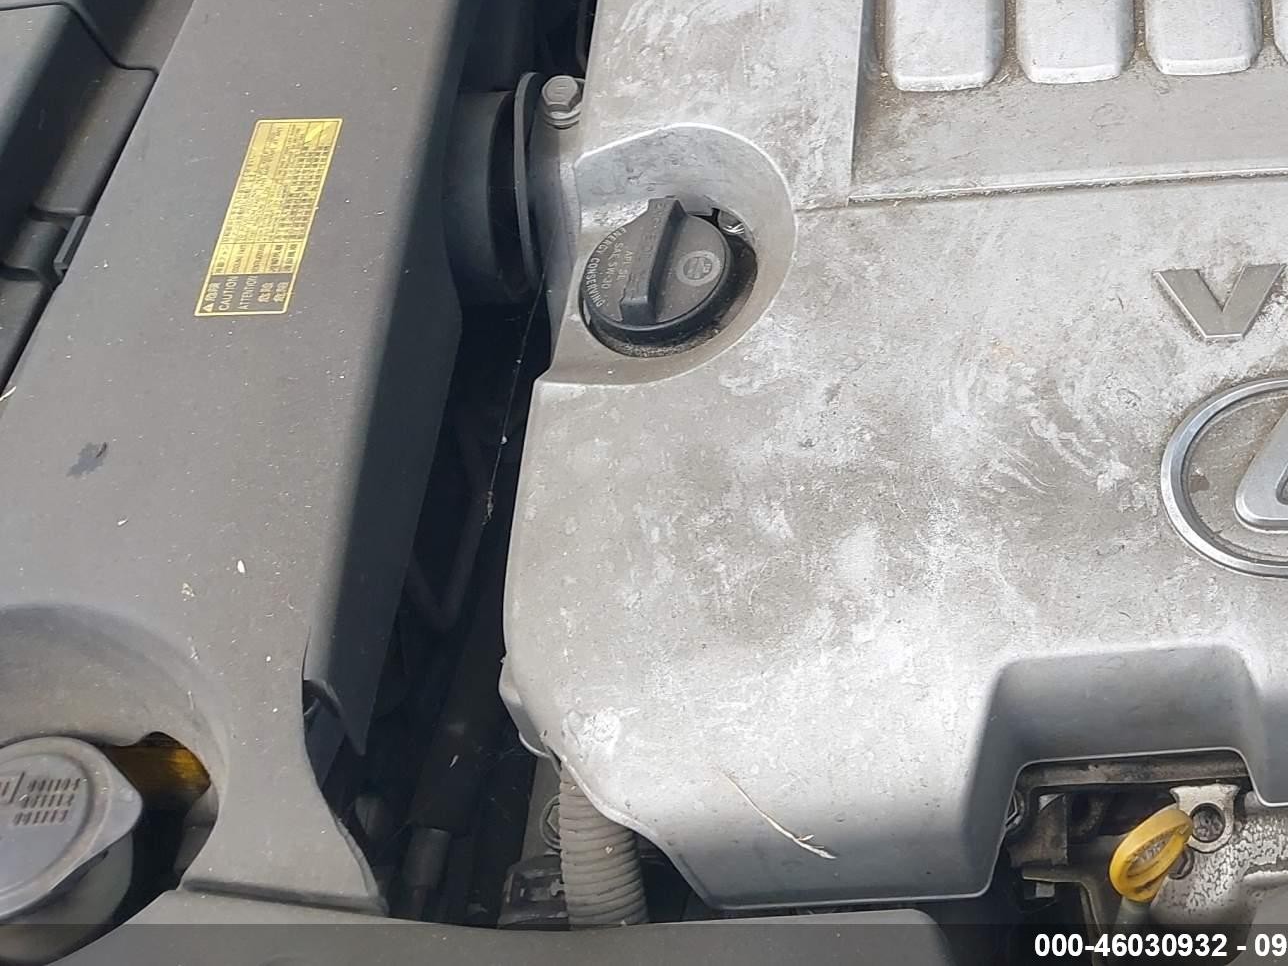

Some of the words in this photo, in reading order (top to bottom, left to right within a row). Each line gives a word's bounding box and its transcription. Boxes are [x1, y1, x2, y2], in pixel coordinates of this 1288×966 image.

[218, 275, 239, 311] CAUTION
[237, 275, 258, 310] ATTENTION
[585, 257, 606, 308] CONSERVING
